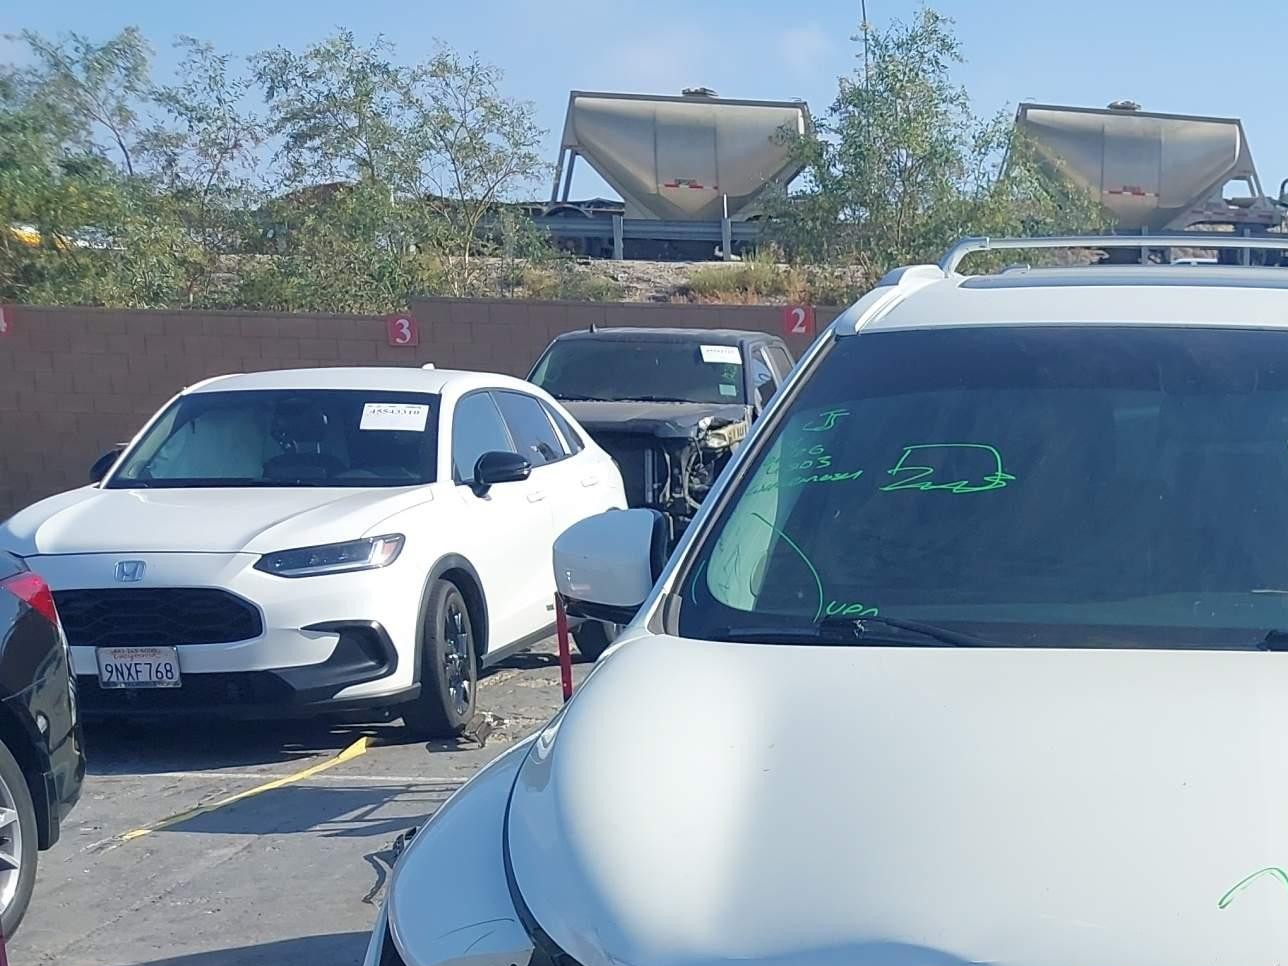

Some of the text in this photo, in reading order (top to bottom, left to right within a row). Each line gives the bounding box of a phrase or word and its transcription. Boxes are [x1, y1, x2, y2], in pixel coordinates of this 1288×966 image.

[394, 318, 412, 344] 3
[791, 307, 807, 334] 2
[104, 663, 175, 681] 9NXF768
